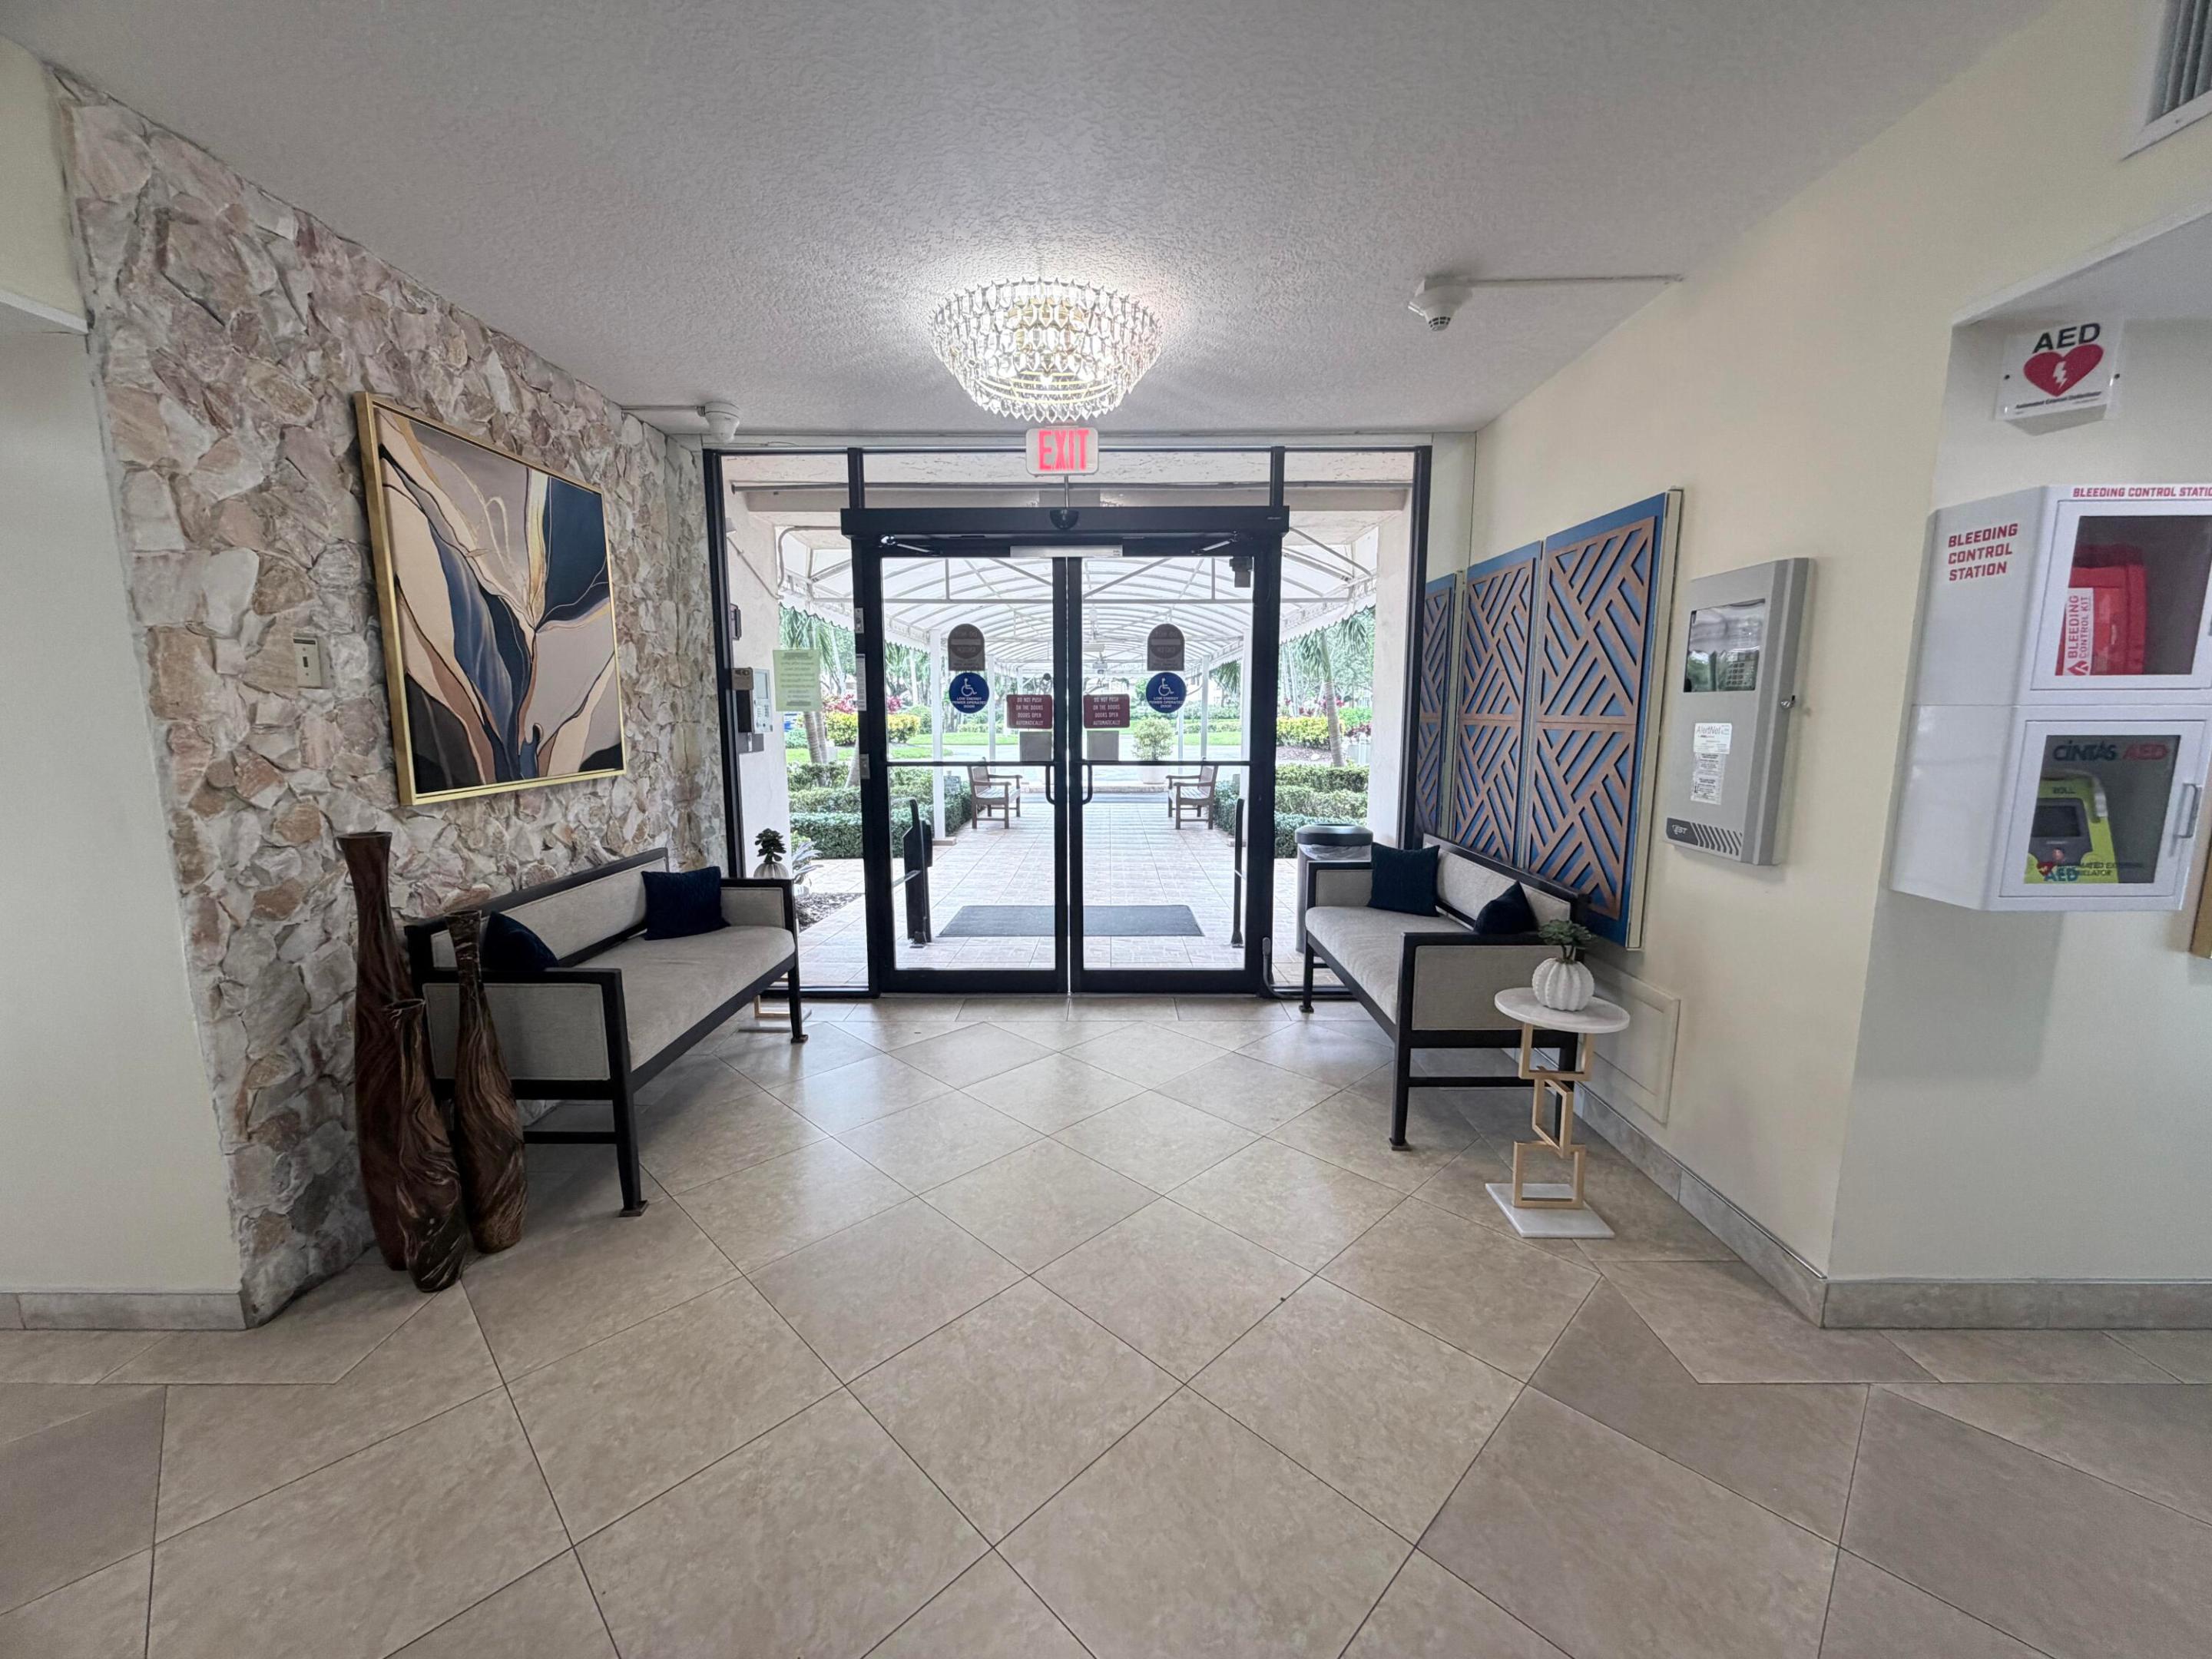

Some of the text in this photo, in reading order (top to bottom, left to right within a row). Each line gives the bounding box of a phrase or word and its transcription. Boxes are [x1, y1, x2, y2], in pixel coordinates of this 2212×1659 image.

[2032, 323, 2101, 354] AED
[1038, 429, 1089, 471] EXIT
[2072, 487, 2125, 498] BLEEDING
[2128, 487, 2176, 497] CONTROL
[1948, 523, 2018, 548] BLEEDING
[1948, 542, 2013, 565] CONTROL
[1949, 561, 2008, 581] STATION
[2068, 595, 2079, 658] BLEEDING
[2079, 615, 2088, 658] CONTROL
[2044, 867, 2079, 882] AED
